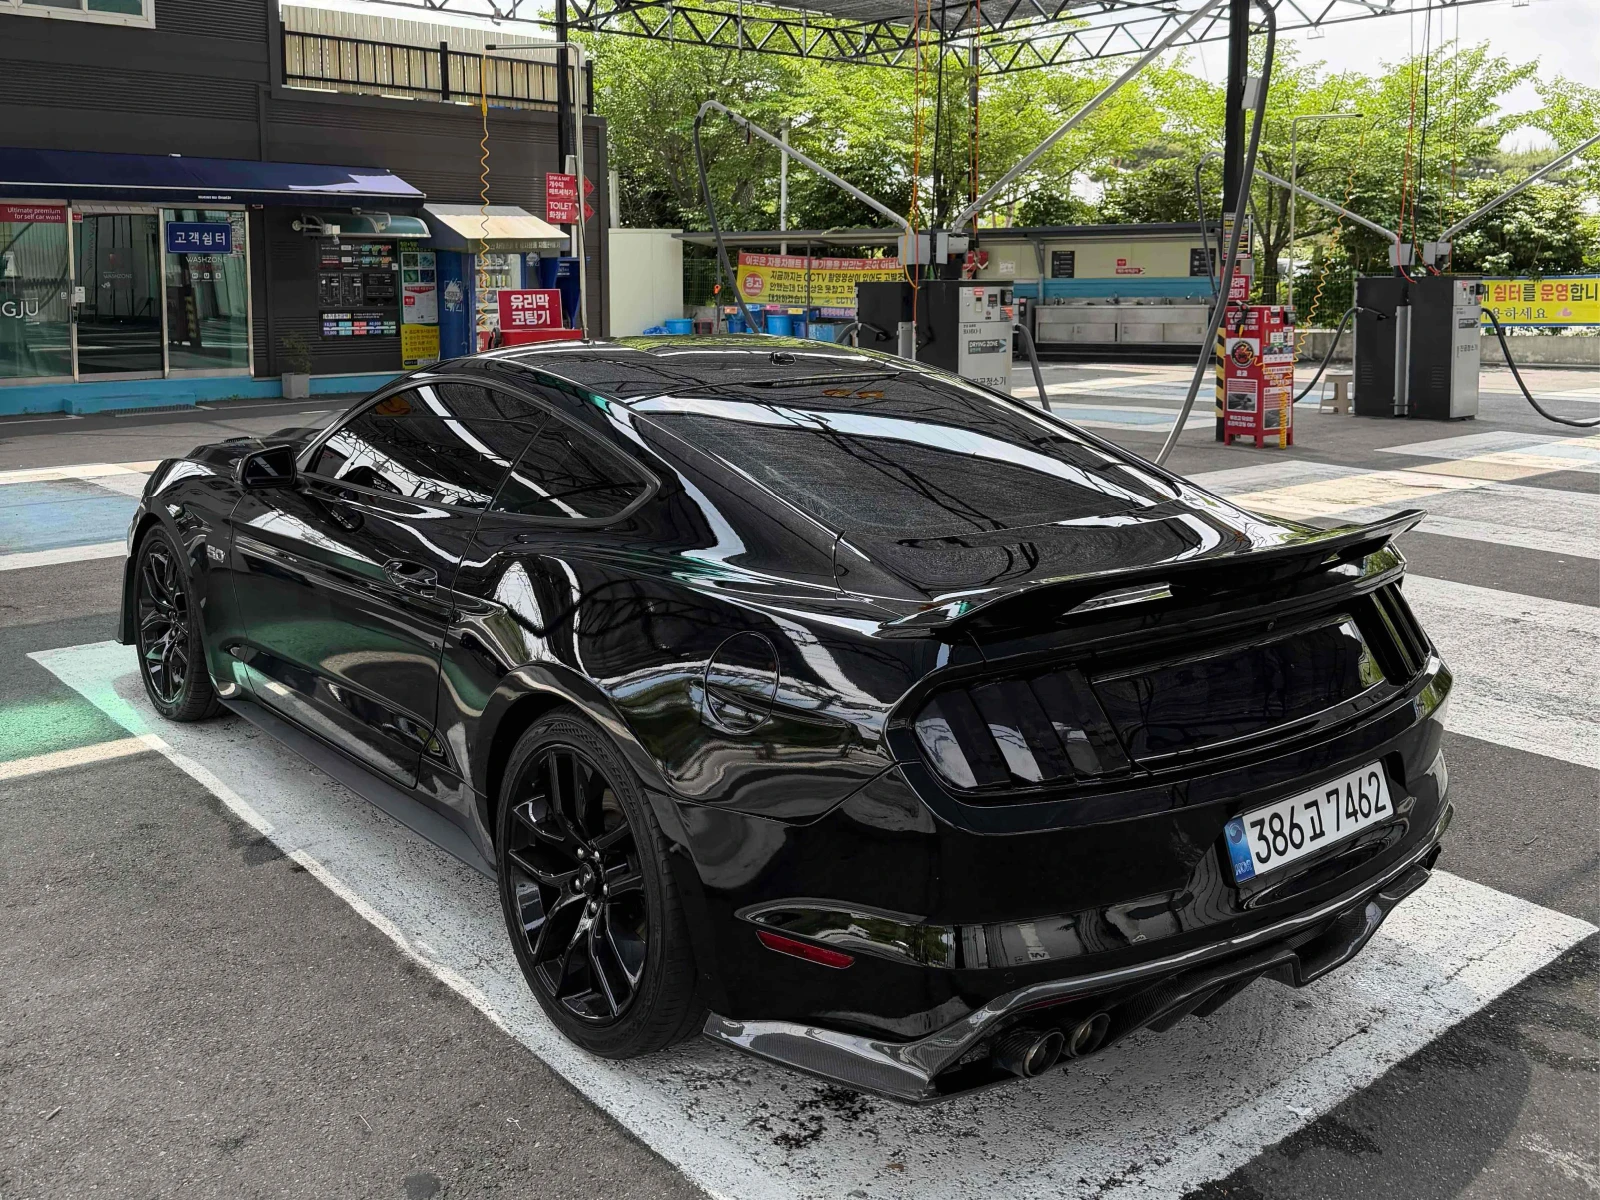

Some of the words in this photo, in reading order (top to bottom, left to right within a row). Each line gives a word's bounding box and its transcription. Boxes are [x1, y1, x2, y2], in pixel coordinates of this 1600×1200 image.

[549, 202, 572, 210] TOILET
[549, 211, 567, 220] 화장실
[174, 232, 226, 246] 고객쉼터
[746, 256, 766, 266] 이곳은
[767, 257, 802, 268] 자동차매트
[842, 260, 862, 270] 버리는
[864, 260, 879, 270] 곳이
[746, 277, 762, 288] 경고
[770, 270, 802, 282] 지금까지는
[804, 272, 826, 282] CCTV
[862, 273, 882, 282] 있어도
[770, 282, 796, 293] 안했는데
[846, 285, 856, 294] 적
[1494, 283, 1536, 302] 쉼터를
[1540, 283, 1598, 302] 운영합니
[510, 294, 550, 310] 유리막
[0, 301, 38, 318] GJU
[512, 310, 550, 325] 코팅기
[986, 340, 998, 348] ZONE
[1250, 799, 1325, 864] 386고
[1326, 771, 1386, 832] 7462
